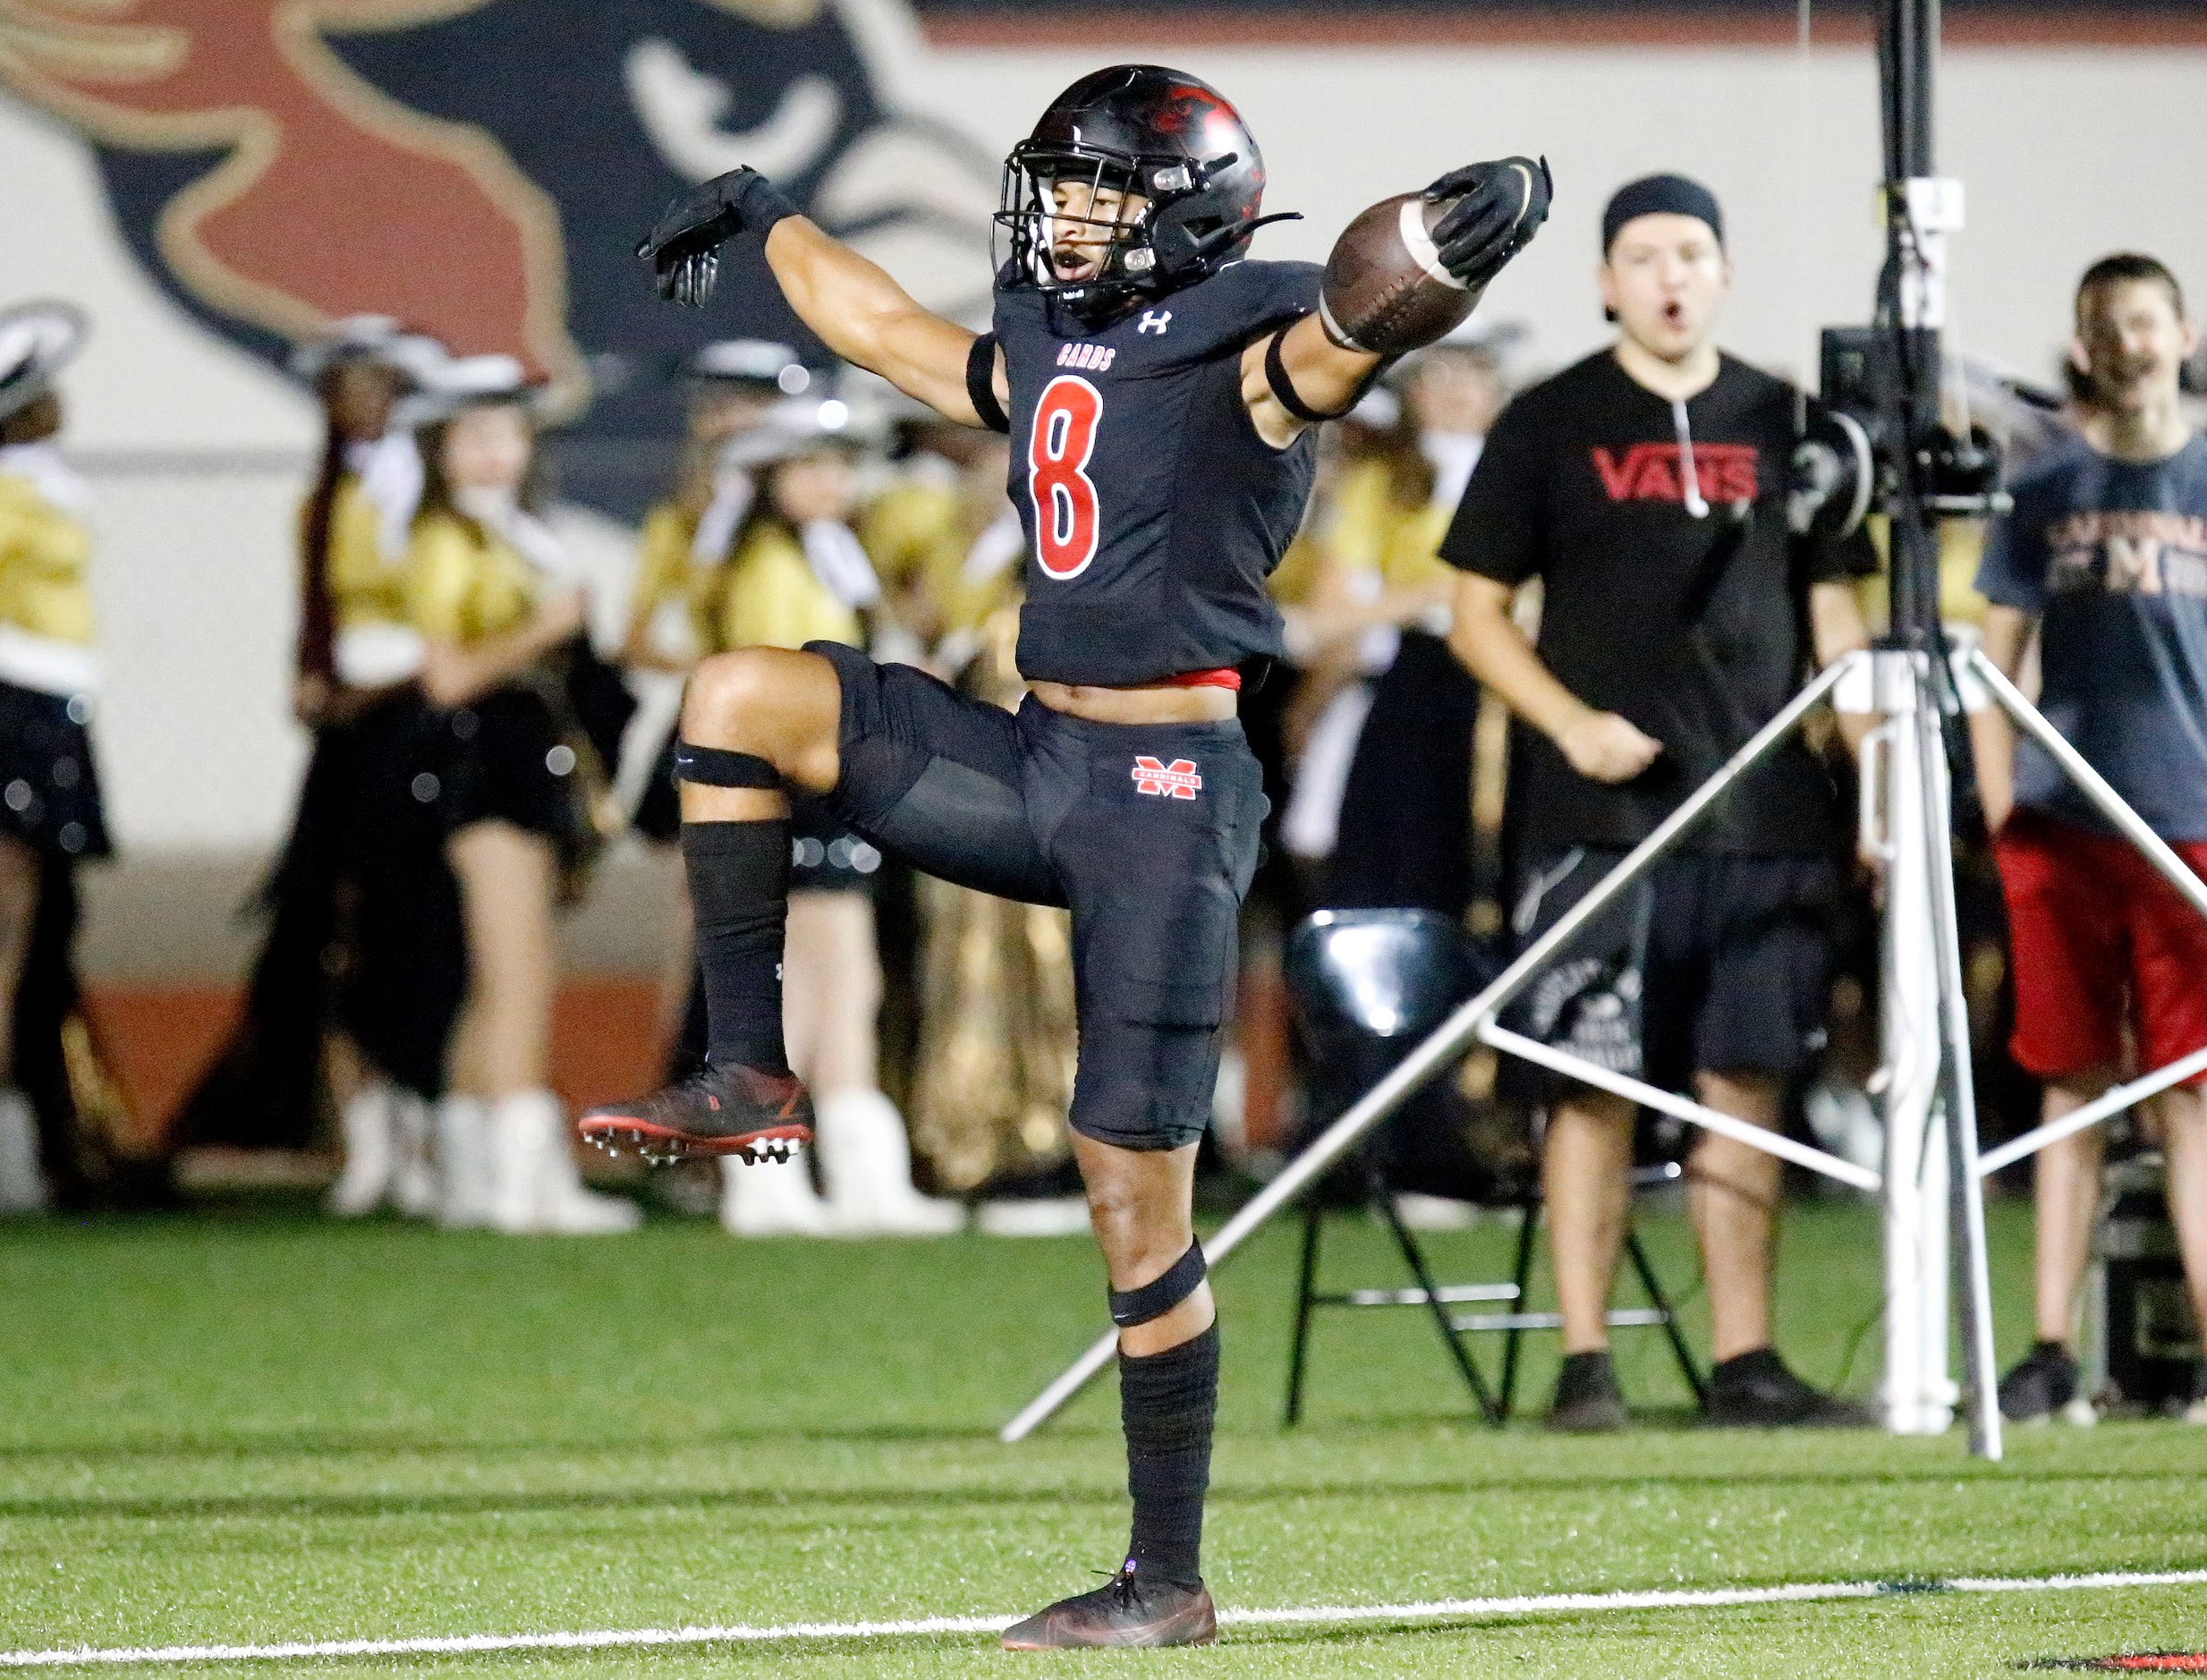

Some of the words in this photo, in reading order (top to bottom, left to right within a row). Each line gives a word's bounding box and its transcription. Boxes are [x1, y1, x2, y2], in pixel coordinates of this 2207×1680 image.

[1057, 343, 1116, 371] CARDS
[1029, 374, 1104, 581] 8
[1592, 443, 1757, 501] VANS
[1139, 771, 1196, 785] CARDINALS
